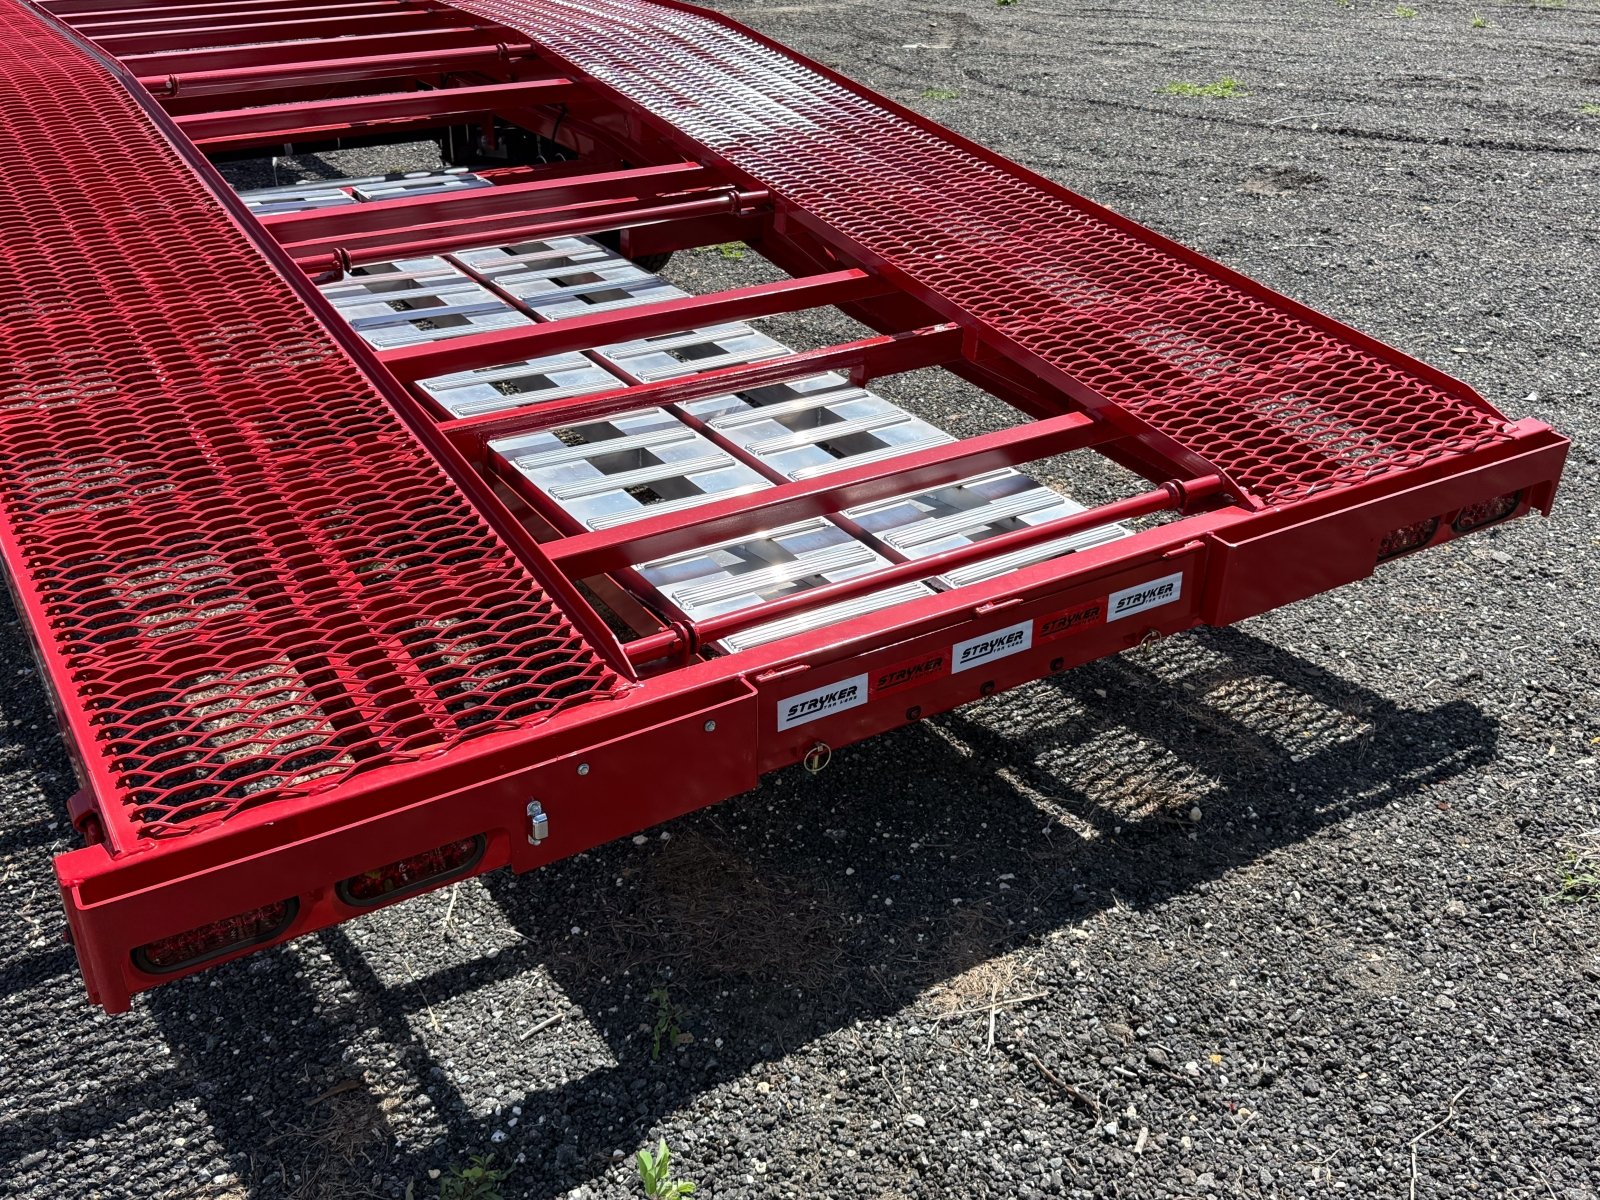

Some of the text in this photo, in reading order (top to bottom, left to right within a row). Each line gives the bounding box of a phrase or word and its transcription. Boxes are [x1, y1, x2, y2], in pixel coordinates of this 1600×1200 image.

[1115, 582, 1174, 614] STRYKER
[1040, 607, 1101, 638] STRYKER
[960, 630, 1024, 665] STRYKER
[876, 656, 944, 692] STRYKER
[786, 685, 858, 722] STRYKER
